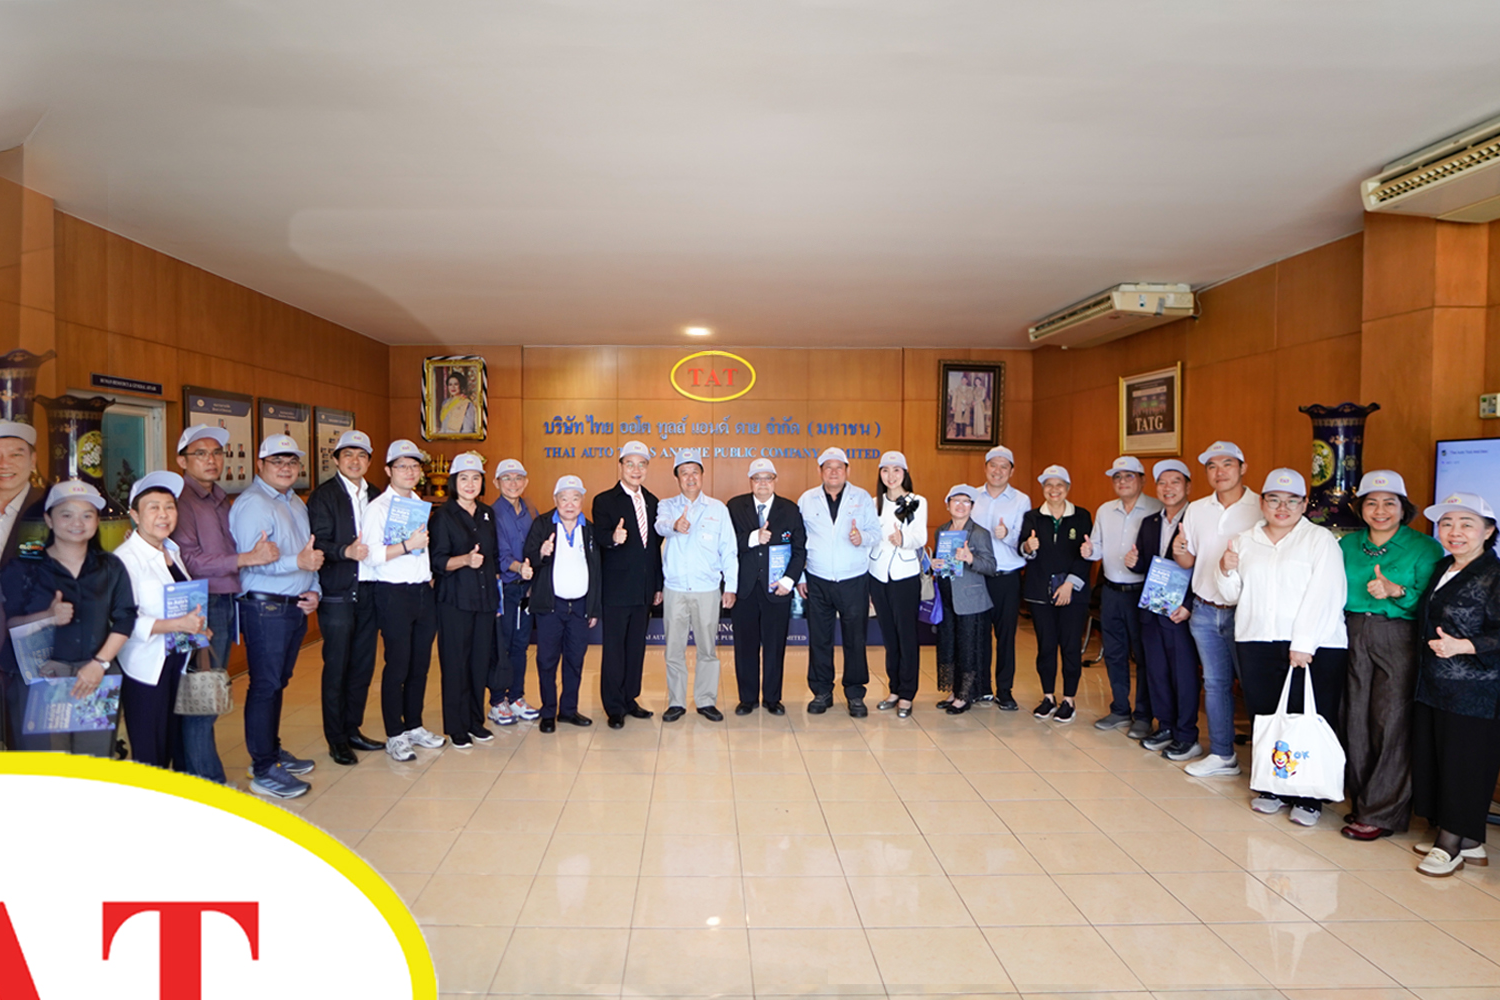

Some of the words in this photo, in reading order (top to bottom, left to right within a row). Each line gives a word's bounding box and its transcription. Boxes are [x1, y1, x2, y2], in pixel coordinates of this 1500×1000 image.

[688, 368, 738, 387] TAT
[544, 415, 584, 434] บริษัท
[586, 415, 613, 434] ไทย
[691, 415, 730, 434] แอนด์
[735, 421, 760, 434] ดาย
[766, 416, 800, 434] จำกัด
[1135, 415, 1163, 432] TATG
[544, 447, 576, 457] THAI
[581, 447, 614, 457] AUTO
[714, 447, 757, 458] PUBLIC
[761, 448, 820, 459] COMPANY
[1294, 751, 1310, 760] OK
